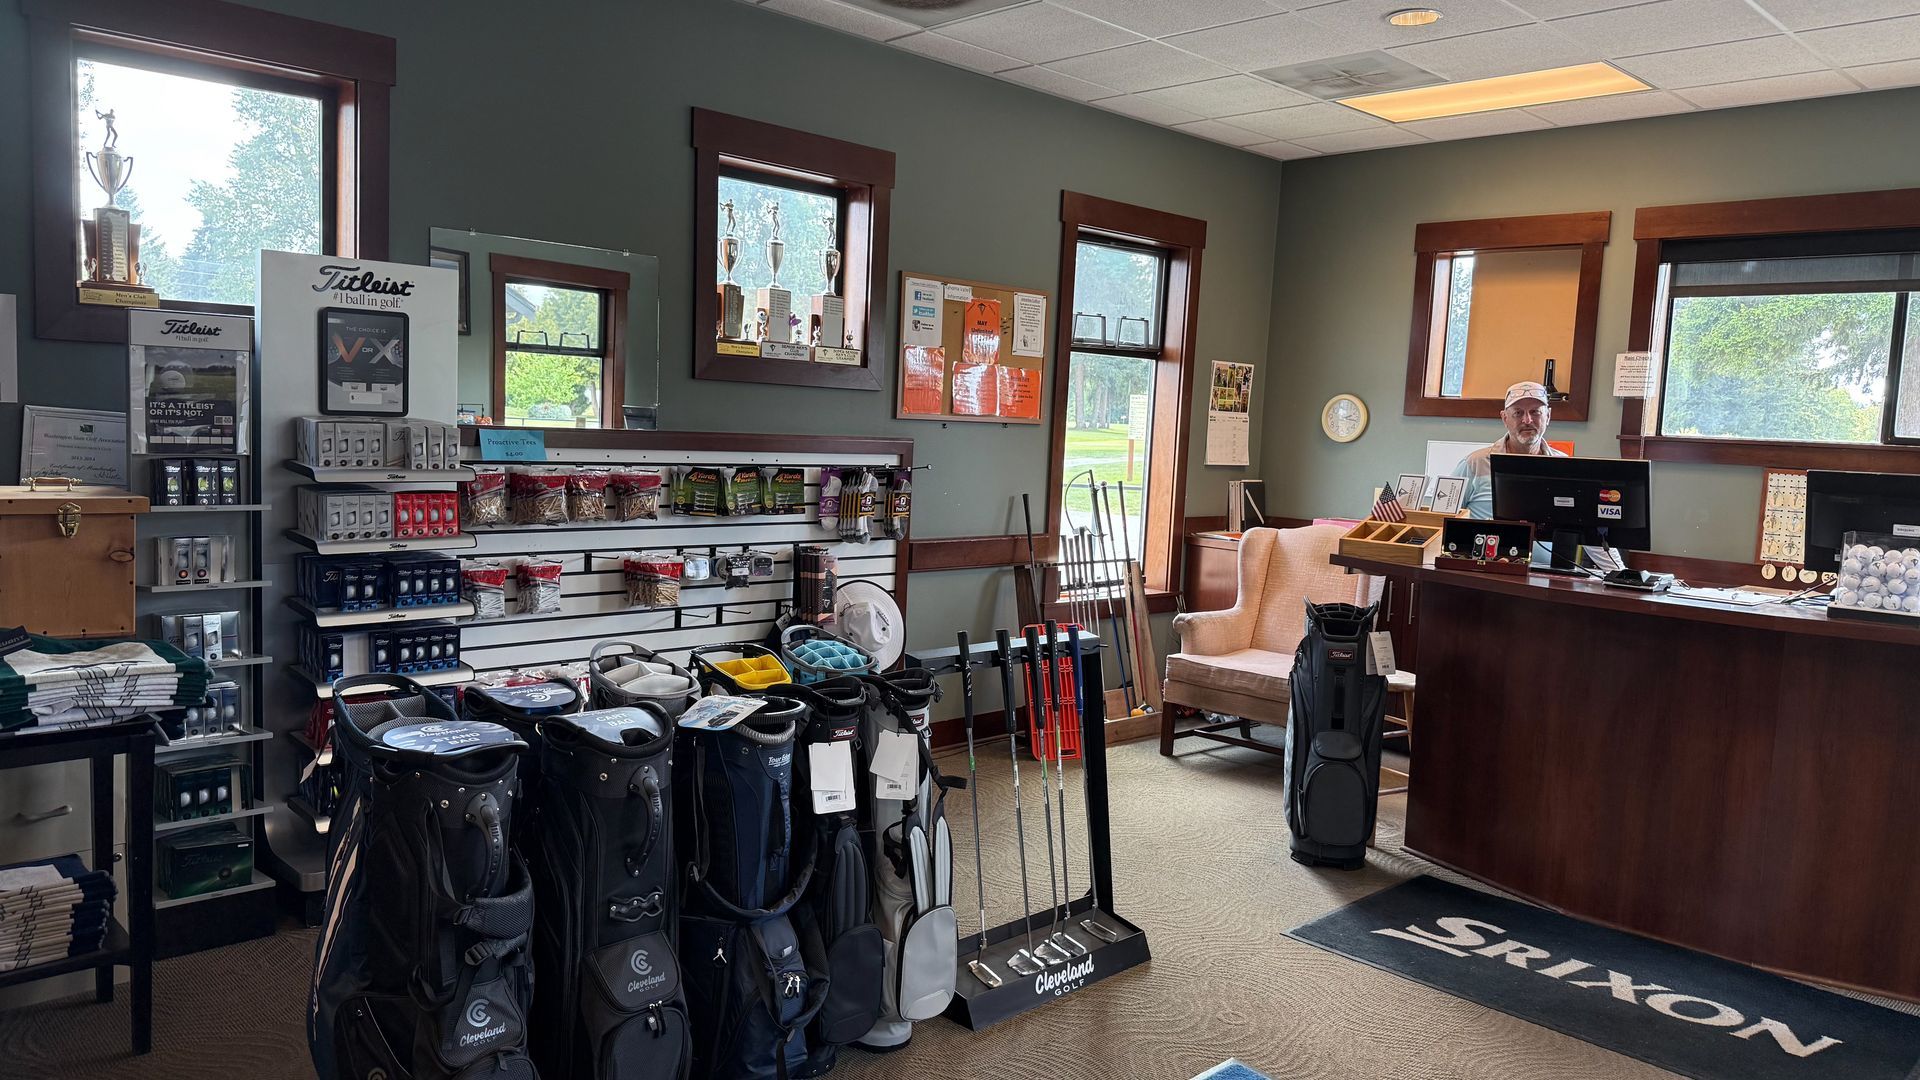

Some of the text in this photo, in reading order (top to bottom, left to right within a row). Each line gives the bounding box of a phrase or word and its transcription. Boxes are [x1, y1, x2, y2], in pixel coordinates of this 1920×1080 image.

[312, 265, 415, 296] Titleist
[346, 292, 365, 305] ball
[367, 295, 378, 306] in
[160, 319, 222, 336] Titleist
[149, 401, 166, 409] IT'S
[177, 402, 215, 410] TITLEIST
[149, 408, 163, 416] OR
[519, 438, 537, 446] Tees
[689, 471, 717, 480] 4 Yards
[735, 470, 757, 483] 4 Yards
[776, 473, 785, 482] 4
[1600, 508, 1621, 516] VISA
[432, 732, 480, 743] STAND
[448, 737, 481, 745] BAG
[768, 756, 781, 766] Tour
[1035, 953, 1095, 995] Cleveland
[627, 971, 666, 993] Cleveland
[1054, 978, 1085, 996] GOLF
[1404, 916, 1844, 1058] SRIXON
[459, 1022, 507, 1047] Cleveland
